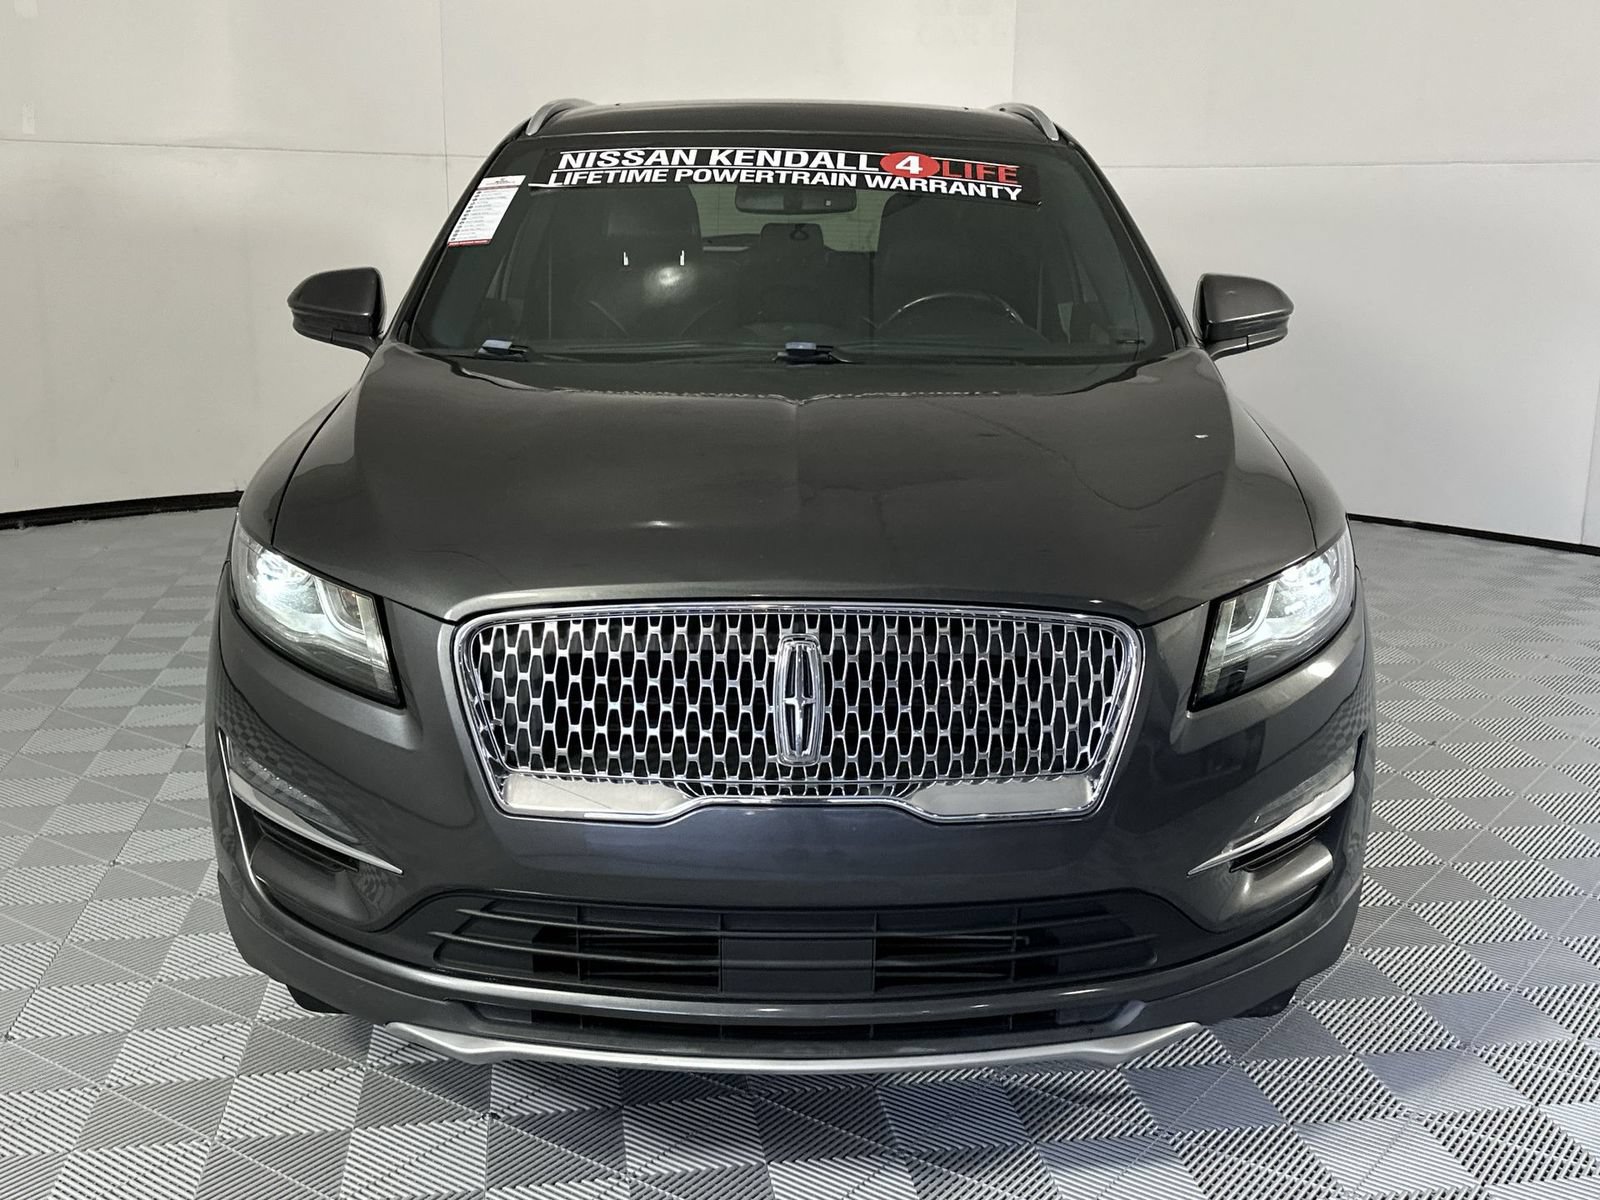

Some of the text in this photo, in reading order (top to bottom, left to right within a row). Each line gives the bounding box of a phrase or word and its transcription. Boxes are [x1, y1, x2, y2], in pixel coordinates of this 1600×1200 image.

[558, 149, 1019, 183] NISSAN KENDALL 4 LIFE
[548, 169, 1022, 201] LIFETIME POWERTRAIN WARRANTY
